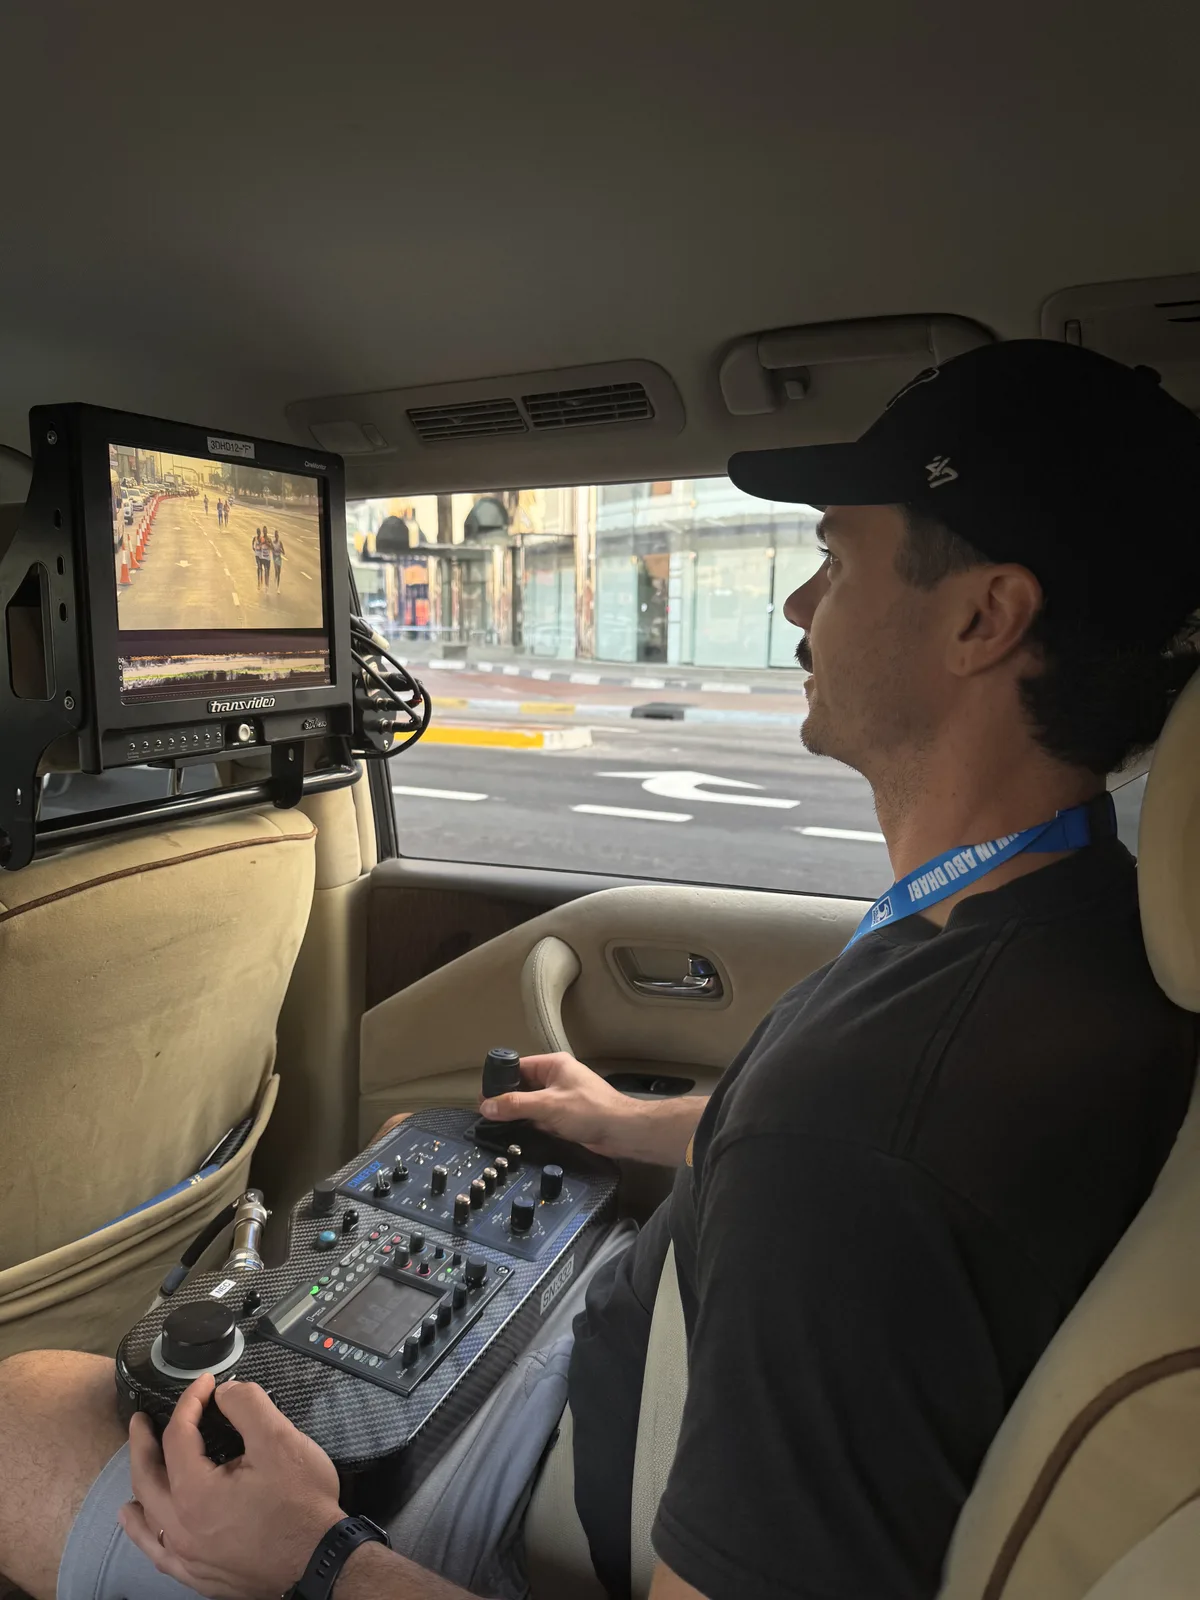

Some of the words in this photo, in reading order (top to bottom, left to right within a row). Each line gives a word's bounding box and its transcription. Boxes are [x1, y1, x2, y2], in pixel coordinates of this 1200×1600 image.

[210, 696, 276, 713] transvideo
[943, 848, 977, 881] ABU
[974, 841, 997, 863] IN
[907, 866, 949, 902] DHABI
[347, 1160, 383, 1188] CINEFLEX
